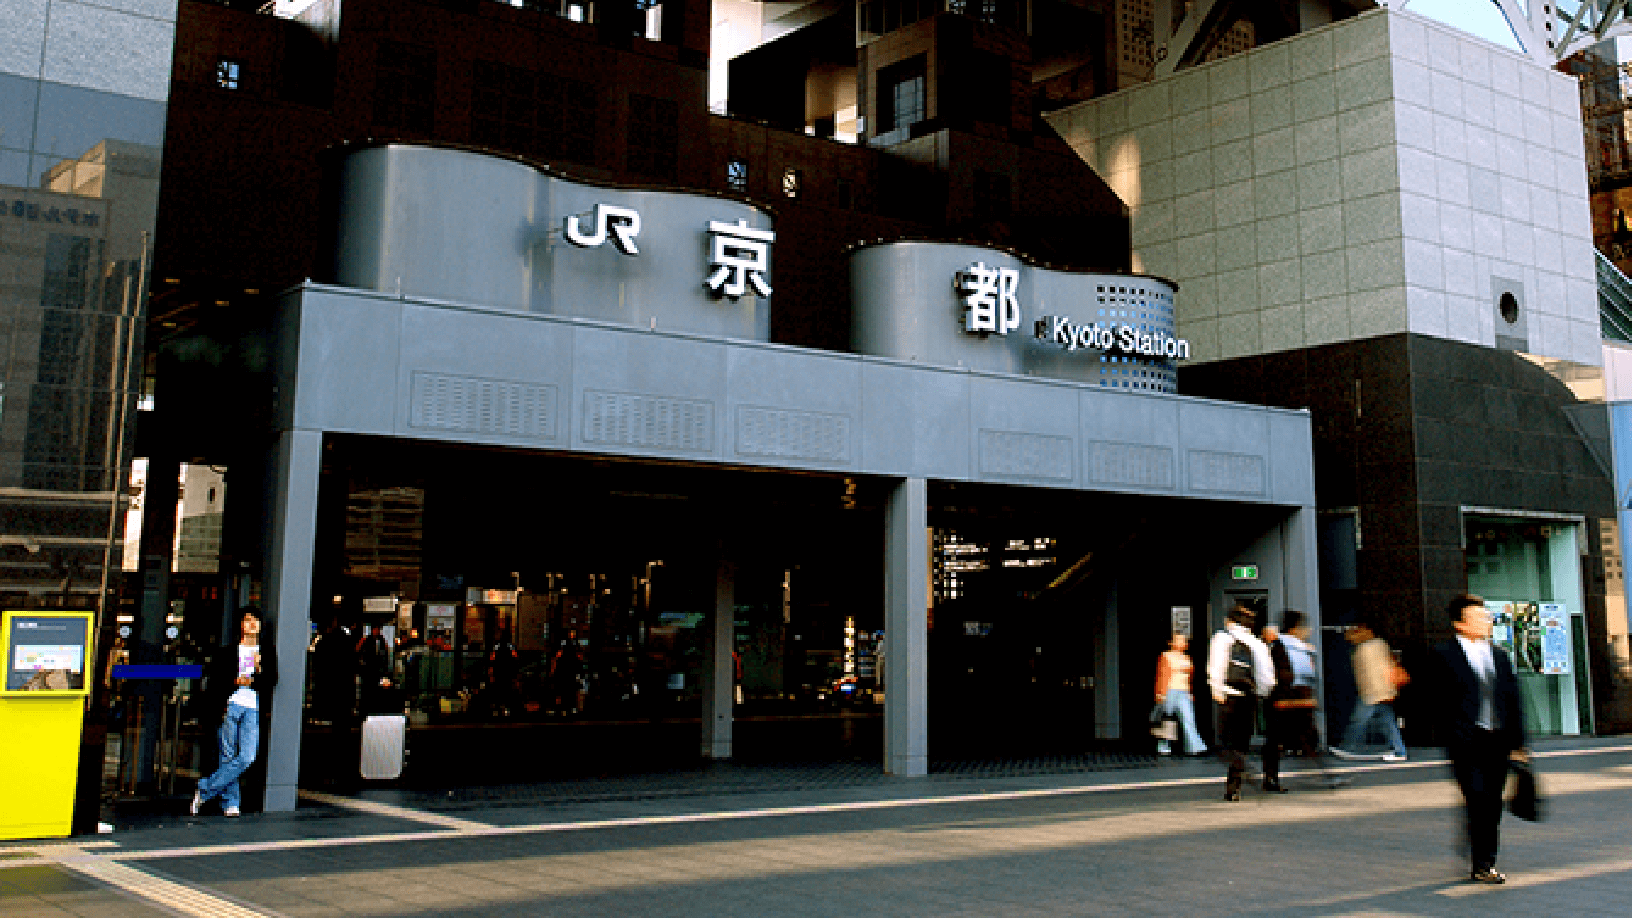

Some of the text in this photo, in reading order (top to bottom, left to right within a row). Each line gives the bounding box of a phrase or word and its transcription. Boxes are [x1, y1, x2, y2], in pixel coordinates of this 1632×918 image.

[566, 203, 640, 256] JR
[708, 219, 1020, 335] 京 都
[1052, 315, 1190, 358] Kyoto Station
